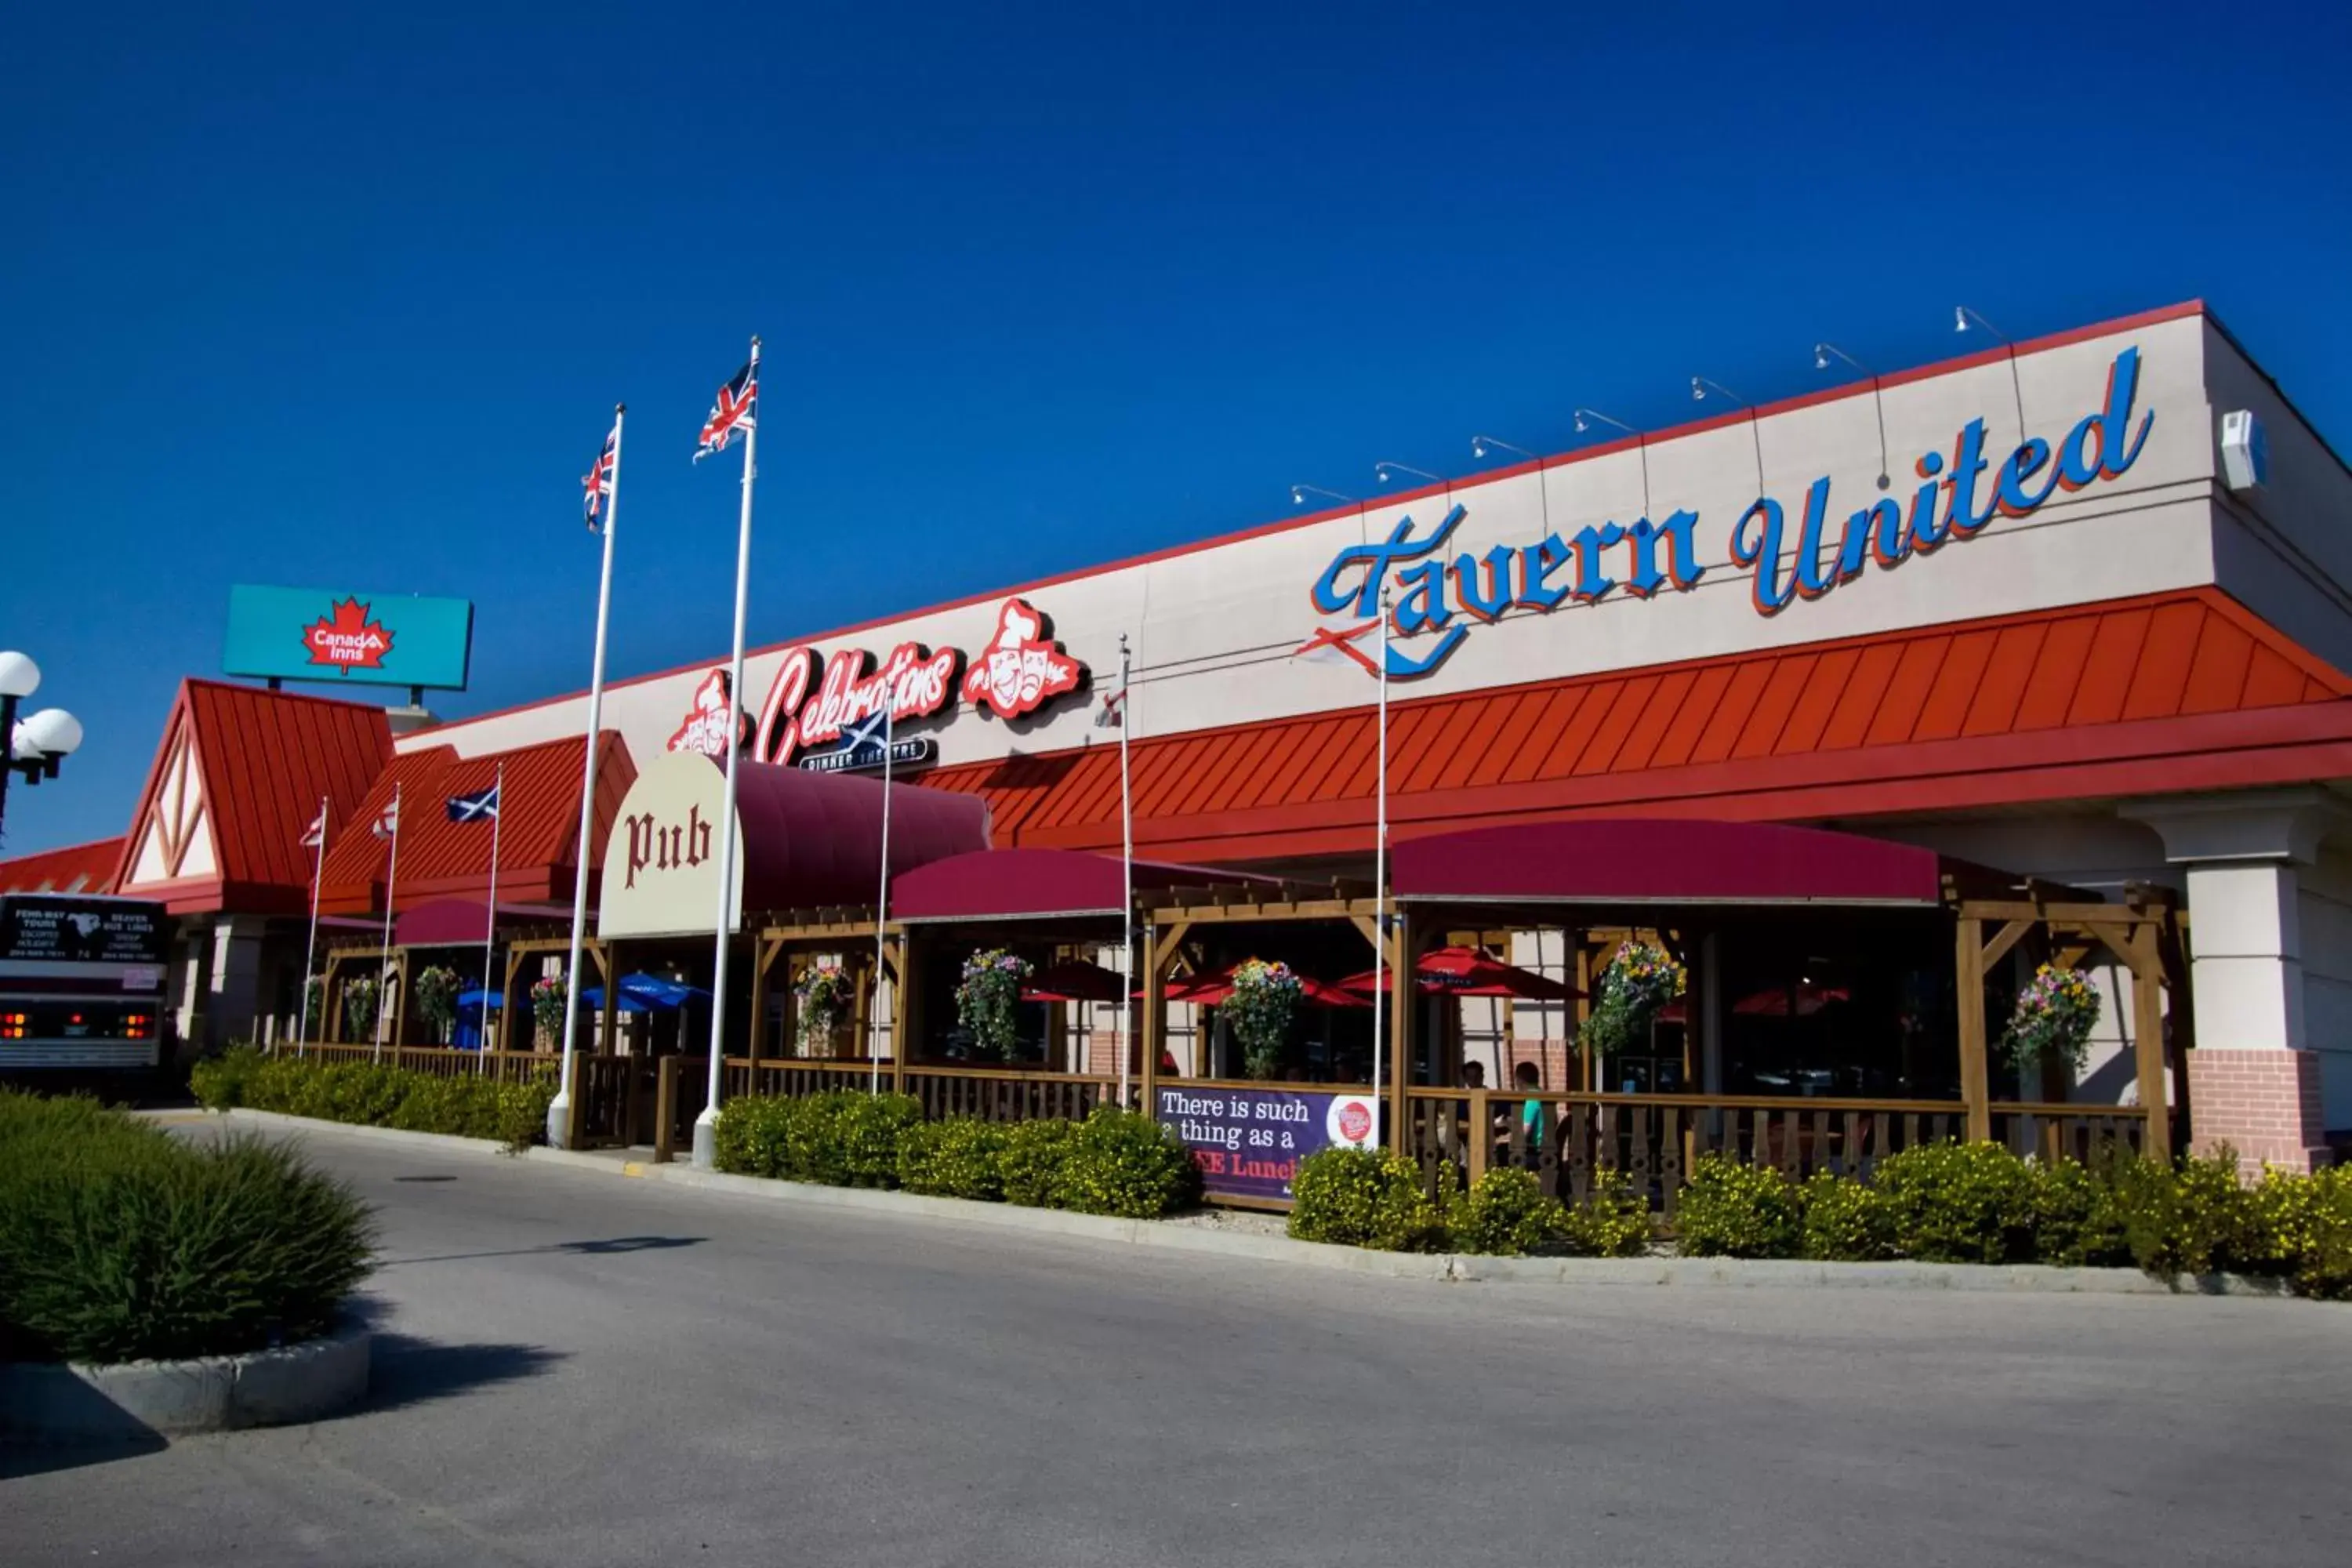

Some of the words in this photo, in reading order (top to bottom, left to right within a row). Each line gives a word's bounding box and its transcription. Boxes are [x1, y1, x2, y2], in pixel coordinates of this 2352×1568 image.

[1311, 503, 1704, 681] Tavern
[1730, 345, 2155, 614] United
[330, 644, 364, 661] Inns
[754, 648, 953, 764] Celebrations
[808, 753, 853, 771] DINNER
[1163, 1091, 1224, 1117] There
[1229, 1095, 1248, 1118] is
[1255, 1099, 1308, 1122] such
[1181, 1119, 1242, 1150] thing
[1249, 1128, 1274, 1147] as
[1281, 1132, 1294, 1149] a
